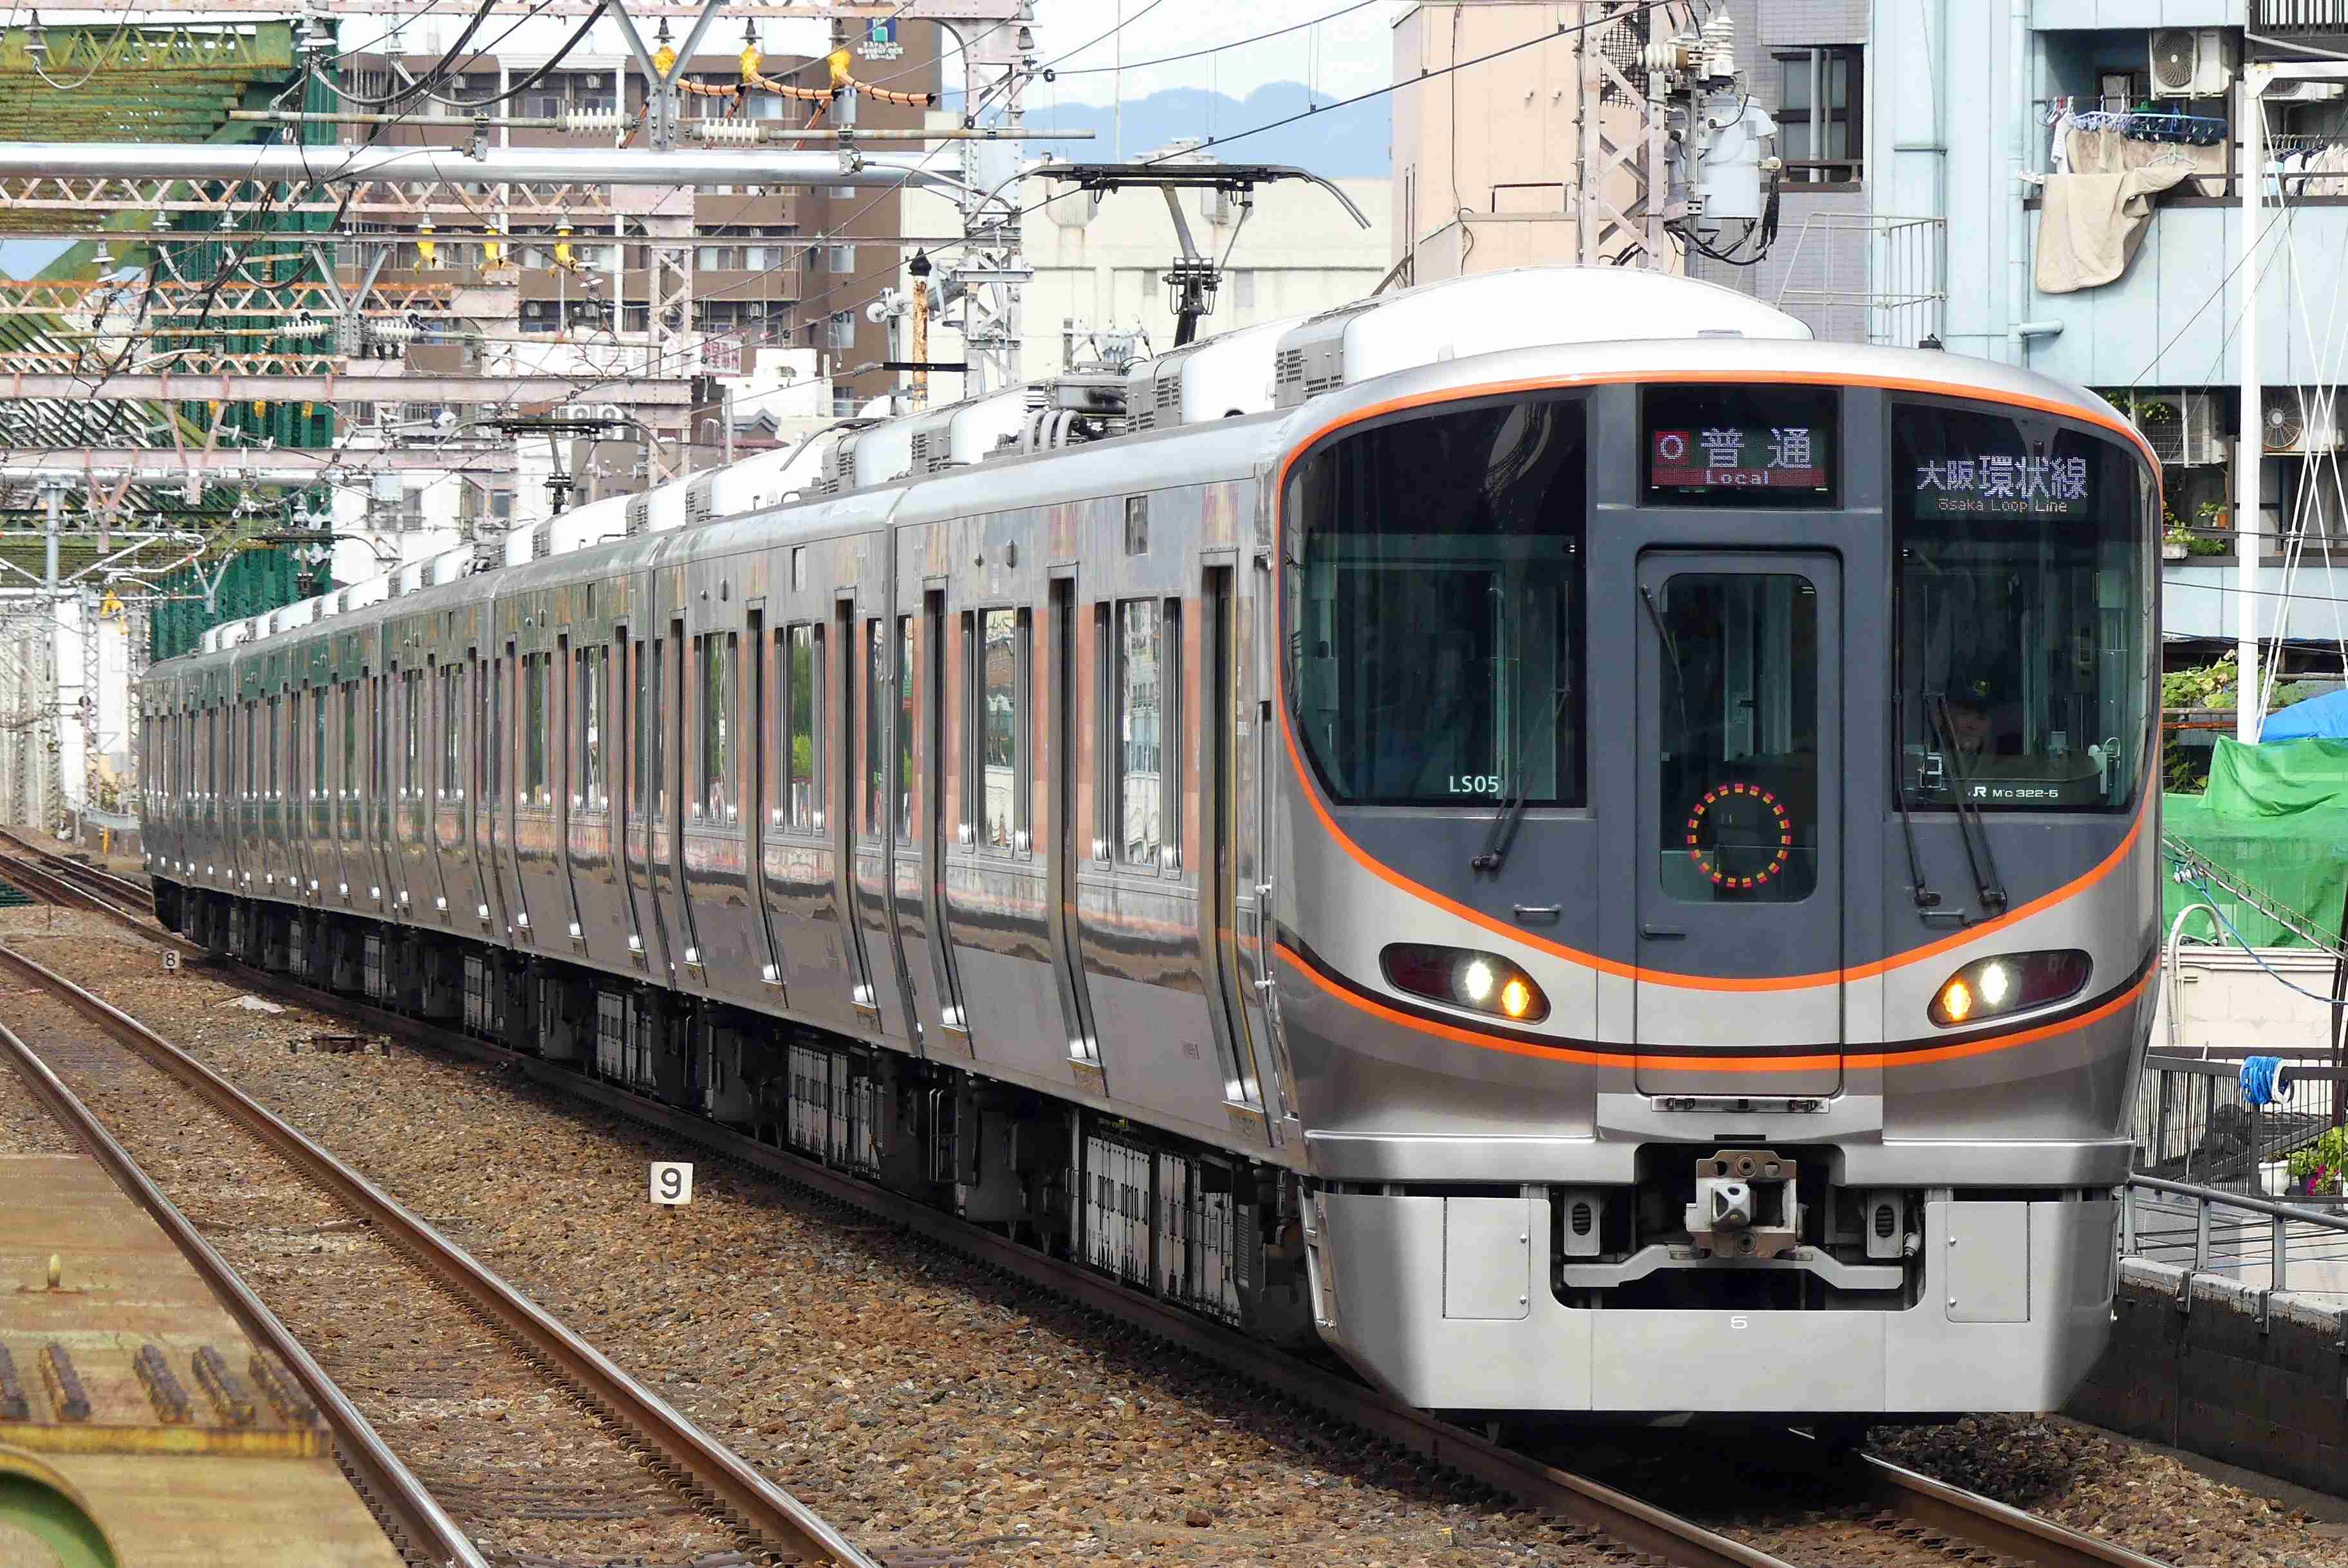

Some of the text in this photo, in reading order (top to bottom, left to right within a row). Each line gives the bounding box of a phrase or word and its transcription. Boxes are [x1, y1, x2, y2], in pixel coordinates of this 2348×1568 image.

[1700, 427, 1812, 468] 普通
[1705, 470, 1770, 484] Local
[1916, 456, 2088, 499] 大阪環状線
[1937, 498, 2068, 513] Osaka Loop Line
[1449, 775, 1499, 793] LS05
[1972, 786, 1987, 798] JR
[166, 952, 176, 966] 8
[660, 1167, 682, 1199] 9
[1730, 1316, 1748, 1329] 5
